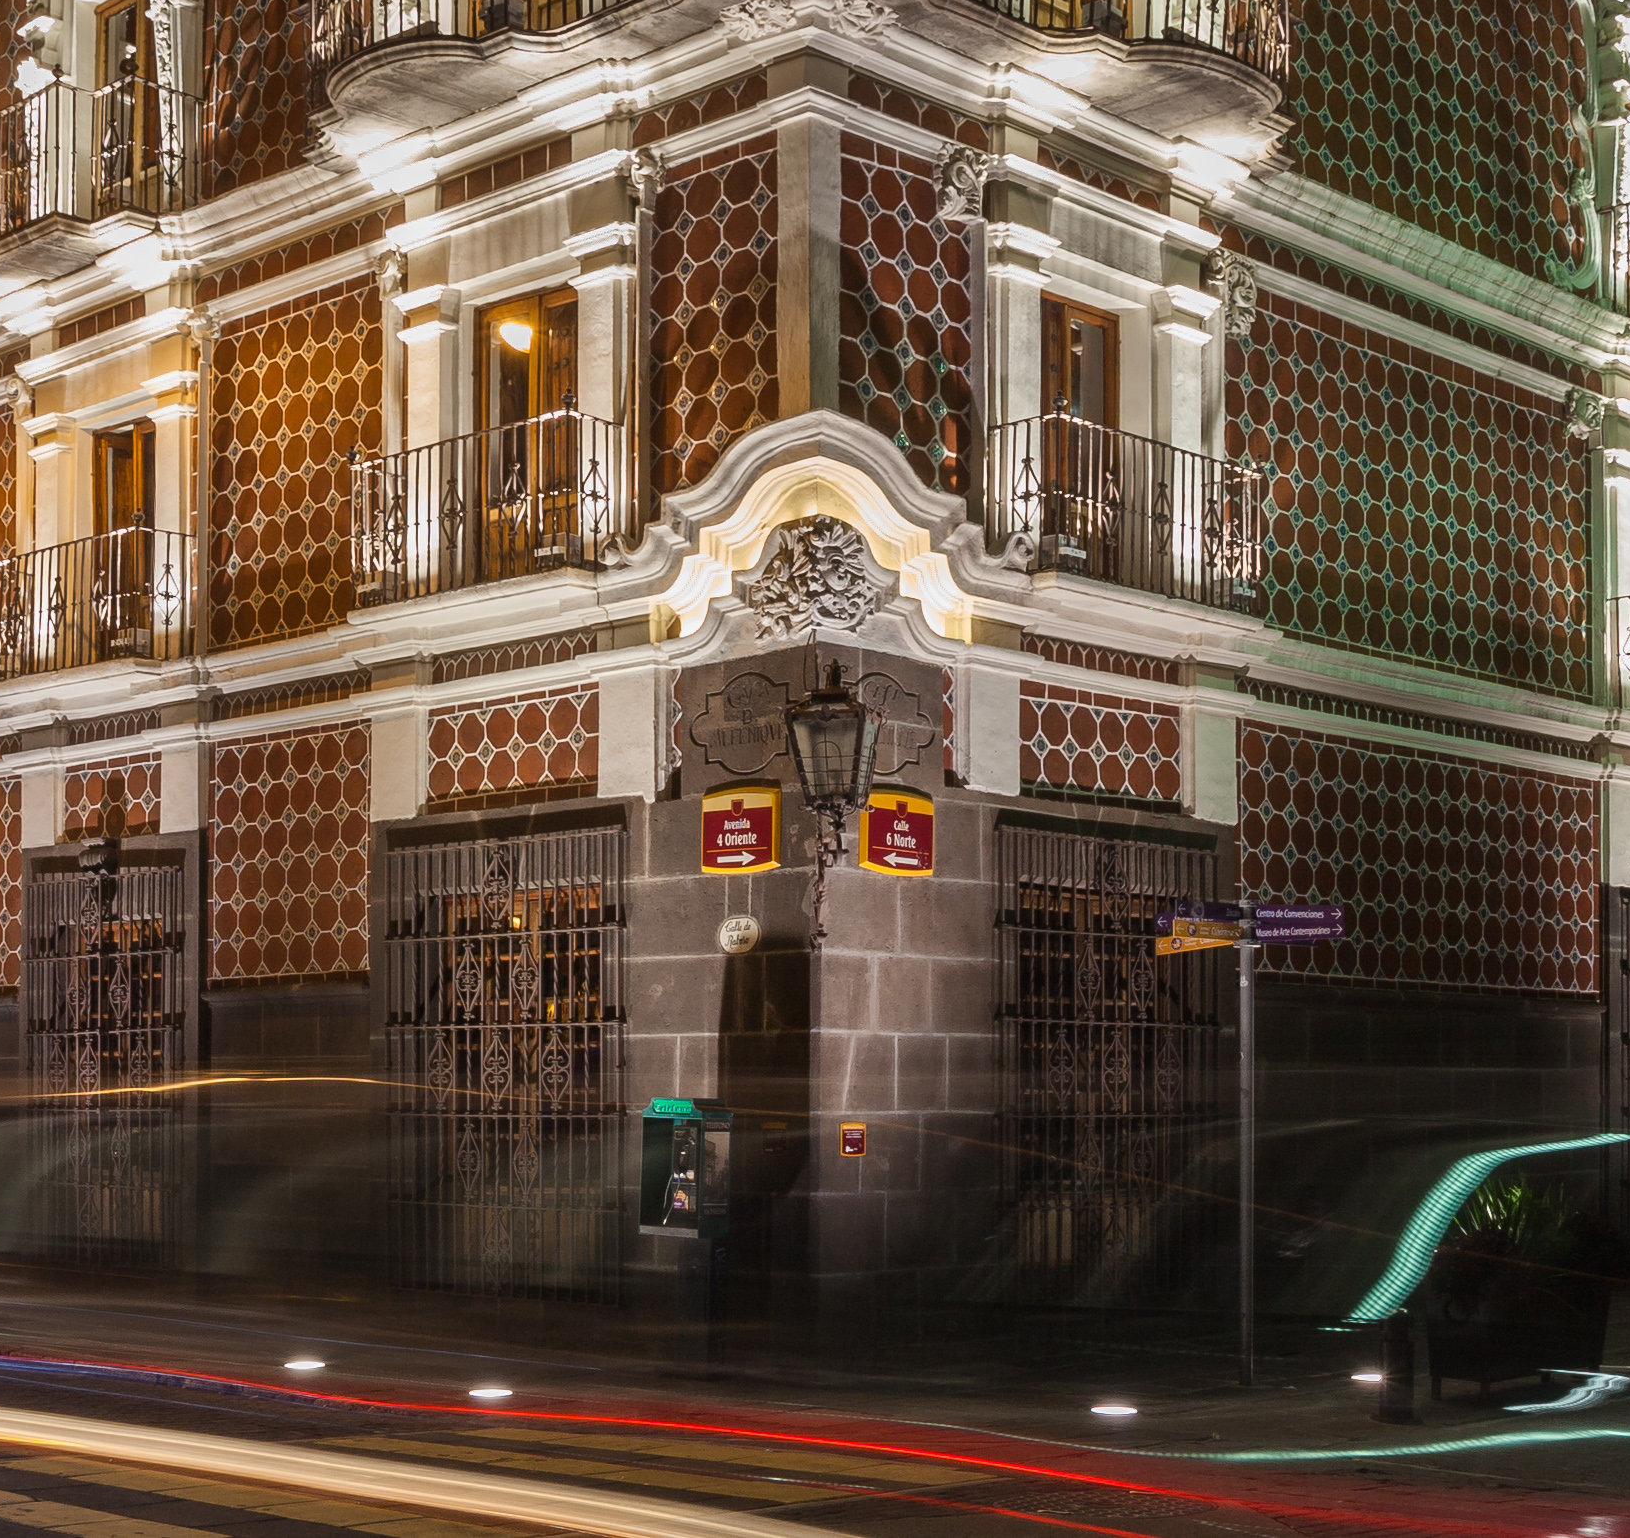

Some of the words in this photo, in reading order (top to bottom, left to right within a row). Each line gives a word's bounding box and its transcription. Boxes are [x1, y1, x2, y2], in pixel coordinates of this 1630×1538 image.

[723, 818, 751, 831] Avenida
[893, 819, 910, 832] Calle
[716, 834, 723, 847] 4
[725, 832, 757, 846] Oriente
[886, 833, 892, 845] 6
[893, 834, 917, 849] Norte
[1256, 908, 1275, 918] Centro
[1276, 909, 1283, 918] de
[1284, 908, 1325, 919] Convenciones
[724, 920, 743, 933] Calle
[1255, 928, 1272, 937] Museo
[1273, 927, 1280, 937] de
[1280, 927, 1290, 936] Arte
